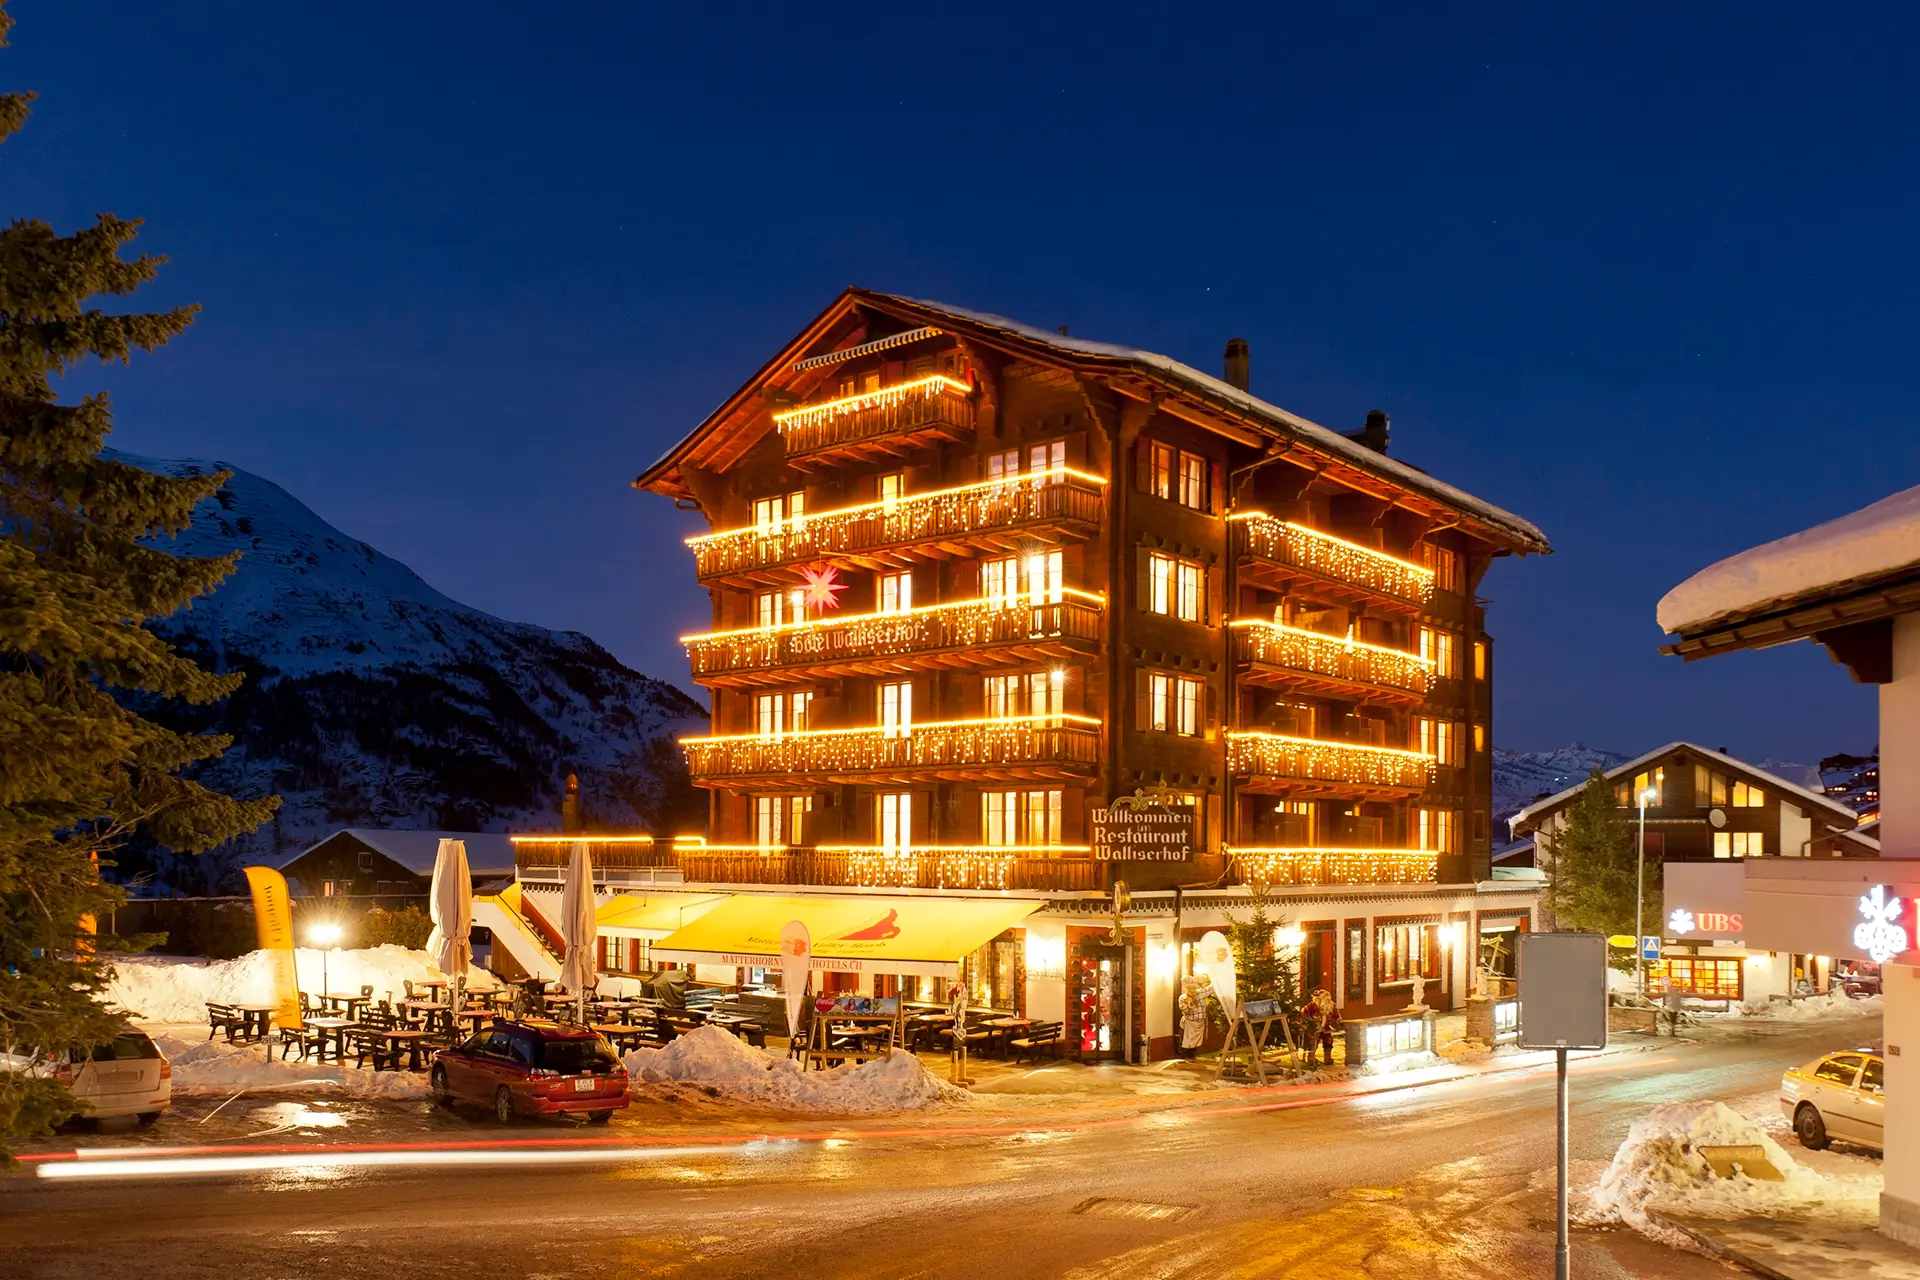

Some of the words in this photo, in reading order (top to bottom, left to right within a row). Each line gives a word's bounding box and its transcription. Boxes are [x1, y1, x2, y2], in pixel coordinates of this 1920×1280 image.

[1092, 808, 1192, 824] Willkommen
[1095, 826, 1188, 844] Restaurant
[1095, 845, 1191, 862] Walliserhof
[1696, 912, 1744, 933] UBS
[721, 954, 863, 970] MATTERHORNHOTELS.CH
